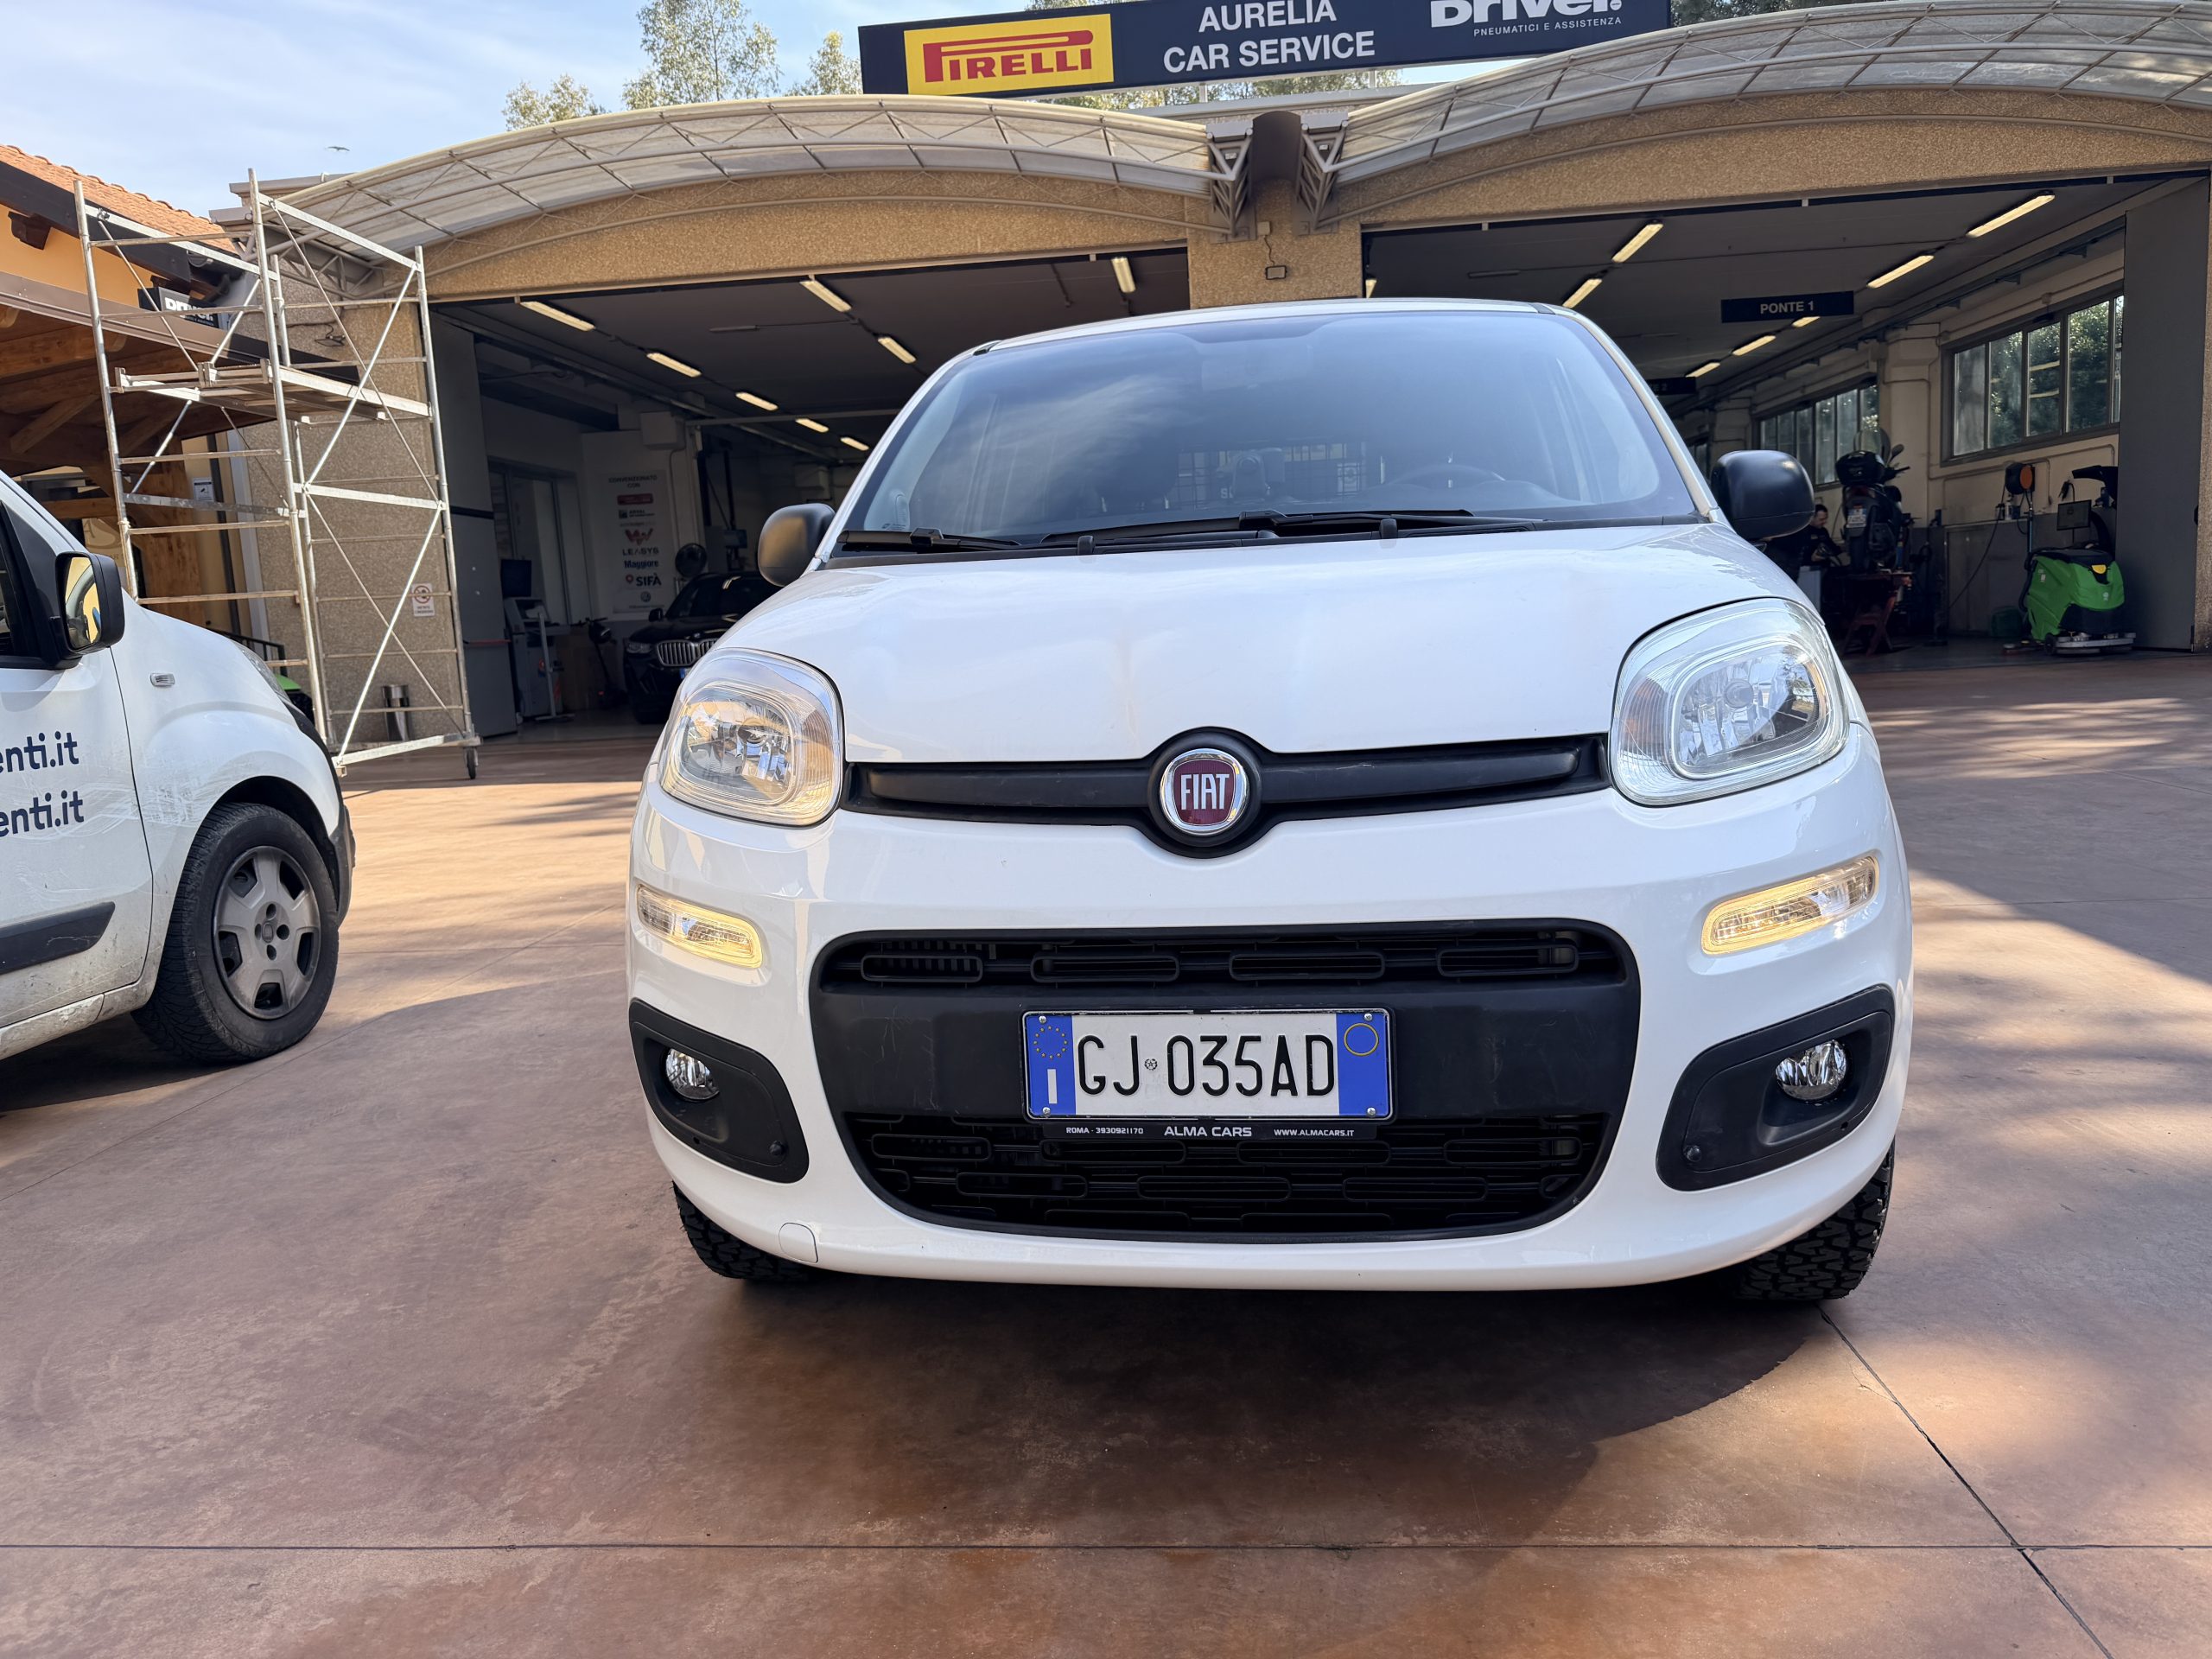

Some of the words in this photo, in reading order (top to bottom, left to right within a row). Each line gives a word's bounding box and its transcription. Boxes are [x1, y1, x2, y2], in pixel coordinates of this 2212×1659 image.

[1198, 0, 1337, 33] AURELIA
[1473, 23, 1539, 37] PNEUMATICI
[1554, 16, 1622, 30] ASSISTENZA
[923, 29, 1094, 83] PIRELLI
[1163, 43, 1230, 73] CAR
[1238, 30, 1375, 67] SERVICE
[1760, 302, 1804, 315] PONTE
[1808, 301, 1815, 311] 1
[624, 560, 659, 569] Maggiore
[636, 572, 662, 587] SIFÀ
[1180, 773, 1230, 810] FIAT
[1164, 1126, 1208, 1136] ALMA
[1211, 1127, 1252, 1137] CARS
[1274, 1128, 1355, 1137] WWW.ALMACARS.IT
